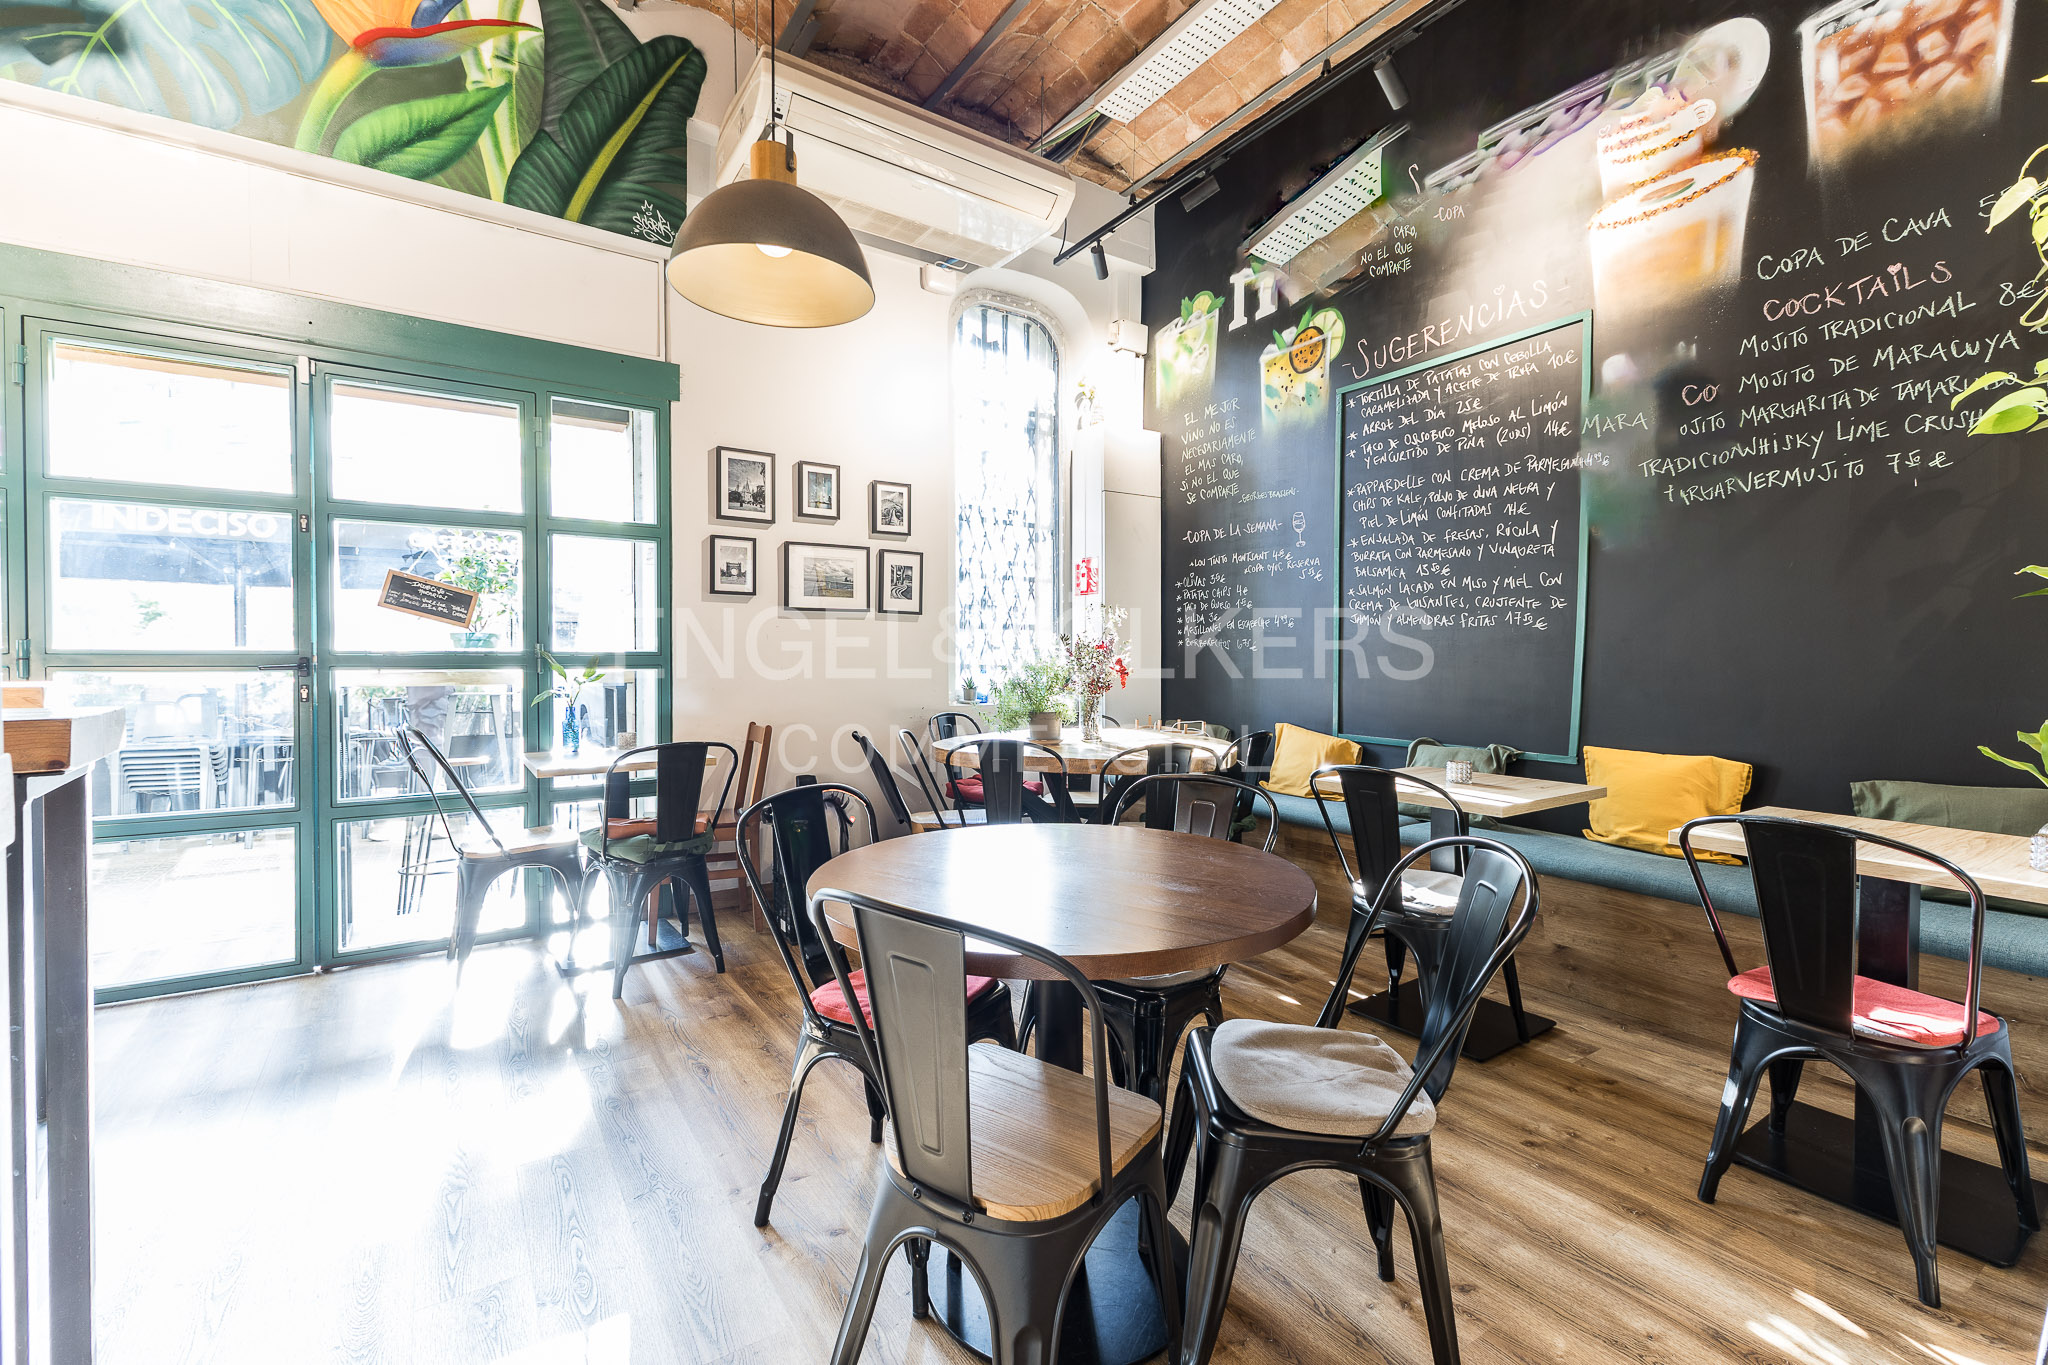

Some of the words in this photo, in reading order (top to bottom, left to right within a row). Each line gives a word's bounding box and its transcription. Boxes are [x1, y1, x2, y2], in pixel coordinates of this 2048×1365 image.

[1360, 252, 1372, 265] NO
[1377, 246, 1389, 260] EL
[1394, 242, 1413, 255] QUE
[1757, 247, 1825, 280] COPA
[1834, 231, 1872, 257] DE
[1882, 208, 1952, 243] CAVA
[1369, 257, 1412, 278] COMPARTE
[1763, 261, 1952, 321] COCKTAILS
[1739, 326, 1808, 358] MOJITO
[1818, 291, 1976, 340] TRADICIONAL
[1356, 384, 1400, 405] TORTILLA
[1406, 377, 1420, 391] DE
[1423, 364, 1471, 385] PATATAS
[1479, 354, 1499, 371] CON
[1504, 341, 1552, 365] CEBOLLA
[1738, 364, 1815, 394] MOJITO
[1828, 355, 1860, 377] DE
[1873, 330, 2020, 371] MARACUYA
[1434, 386, 1441, 403] Y
[1445, 376, 1482, 394] ACEITE
[1484, 372, 1500, 384] DE
[1505, 362, 1540, 379] TRUFA
[1739, 389, 1852, 427] MARGARITA
[1853, 387, 1879, 407] DE
[1181, 428, 1204, 445] VINO
[1209, 421, 1220, 435] NO
[1225, 416, 1236, 430] ES
[1184, 412, 1198, 426] EL
[1398, 412, 1419, 428] DEL
[1837, 417, 1890, 442] LIME
[1361, 441, 1383, 456] TACO
[1388, 438, 1399, 451] DE
[1509, 407, 1526, 422] AL
[1436, 442, 1451, 456] DE
[1185, 464, 1195, 476] EL
[1198, 458, 1217, 471] MAS
[1191, 477, 1203, 489] NO
[1207, 472, 1218, 484] EL
[1223, 468, 1240, 480] QUE
[1432, 469, 1451, 484] CON
[1460, 466, 1500, 481] CREMA
[1505, 461, 1521, 476] DE
[1186, 492, 1197, 505] SE
[1200, 482, 1240, 500] COMPARTE
[1353, 496, 1376, 512] CHIPS
[1380, 496, 1393, 507] DE
[1456, 489, 1468, 502] DE
[1503, 482, 1539, 496] NEGRA
[1547, 482, 1555, 501] Y
[1213, 528, 1226, 539] DE
[1229, 523, 1241, 536] LA
[1359, 514, 1383, 529] PIEL
[1385, 514, 1398, 527] DE
[1360, 532, 1415, 545] ENSALADA
[1421, 532, 1436, 544] DE
[1551, 520, 1558, 544] Y
[1351, 550, 1392, 562] BURRATA
[1395, 548, 1412, 559] CON
[1415, 546, 1471, 560] PARMESANO
[1477, 543, 1484, 561] Y
[1399, 581, 1434, 595] LACADO
[1441, 576, 1456, 589] EN
[1462, 576, 1487, 592] MISO
[1493, 576, 1500, 595] Y
[1504, 573, 1533, 589] MIEL
[1540, 572, 1562, 586] CON
[1349, 599, 1383, 611] CREMA
[1387, 597, 1400, 612] DE
[1475, 596, 1542, 609] CRUJIENTE
[1550, 595, 1567, 609] DE
[1387, 614, 1393, 632] Y
[1396, 615, 1455, 626] ALMENDRAS
[1459, 611, 1498, 628] FRITAS
